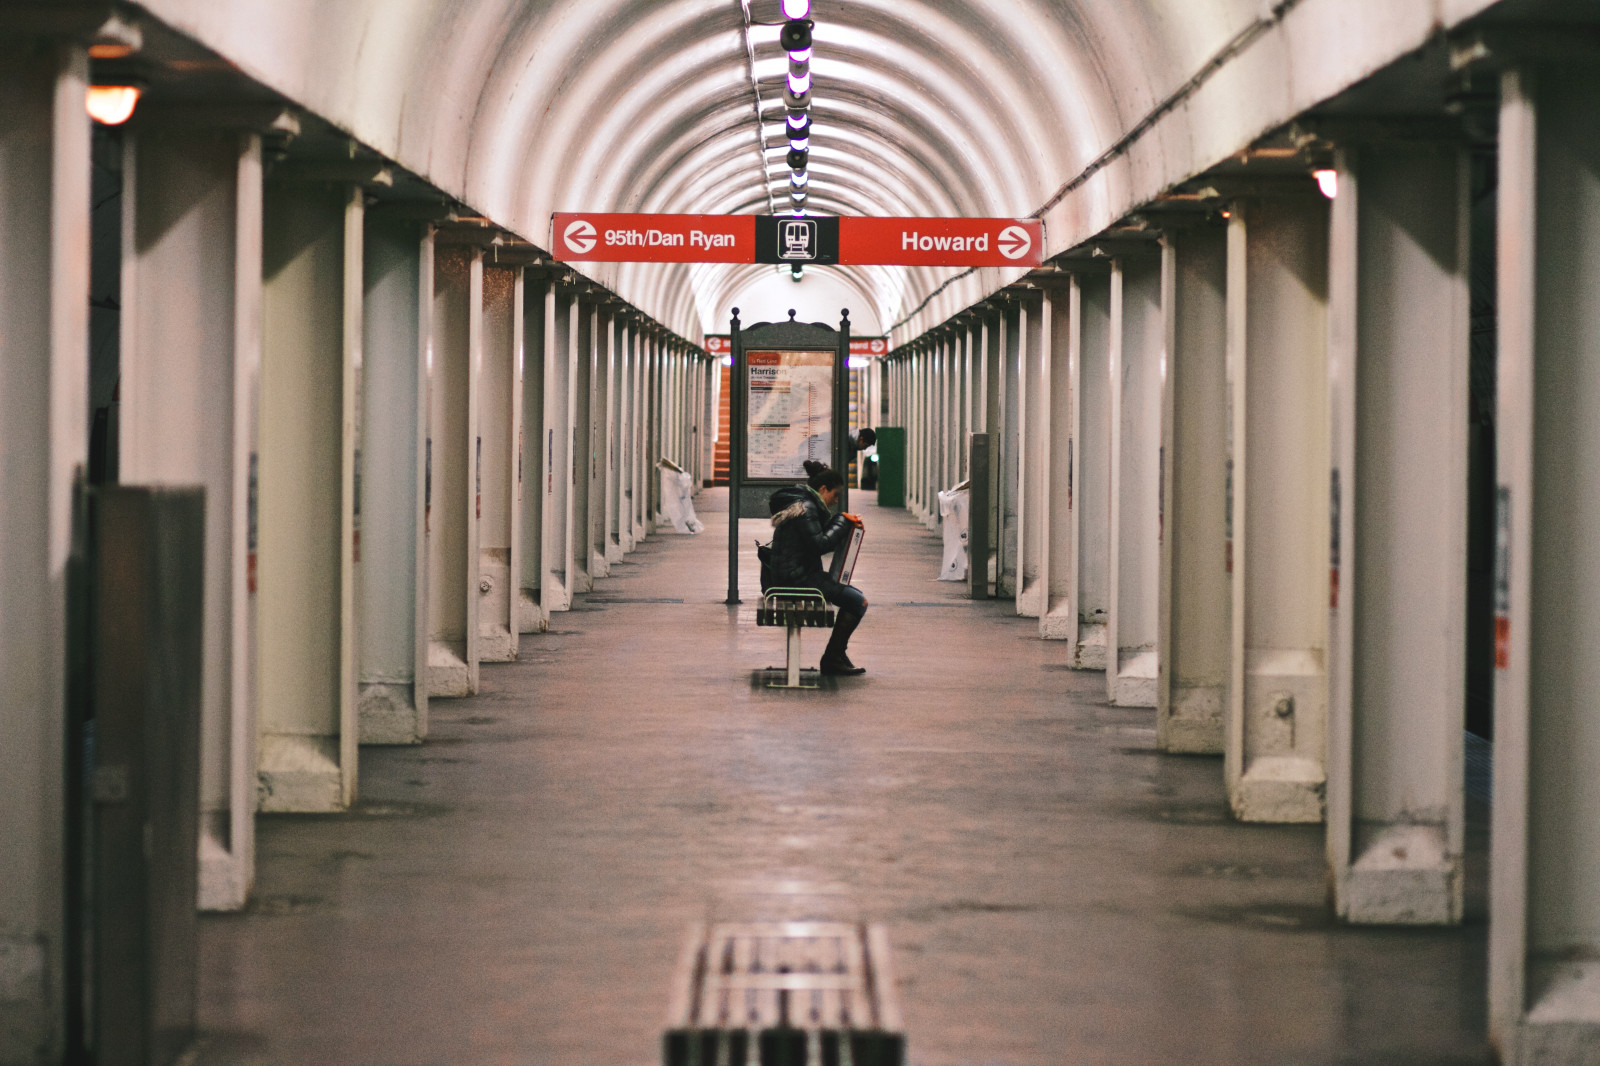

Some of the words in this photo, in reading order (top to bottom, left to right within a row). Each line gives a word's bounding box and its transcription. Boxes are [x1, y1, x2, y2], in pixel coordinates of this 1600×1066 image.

[604, 229, 684, 247] 95th/Dan
[689, 230, 735, 251] Ryan
[901, 231, 989, 251] Howard
[750, 367, 787, 375] Harrison
